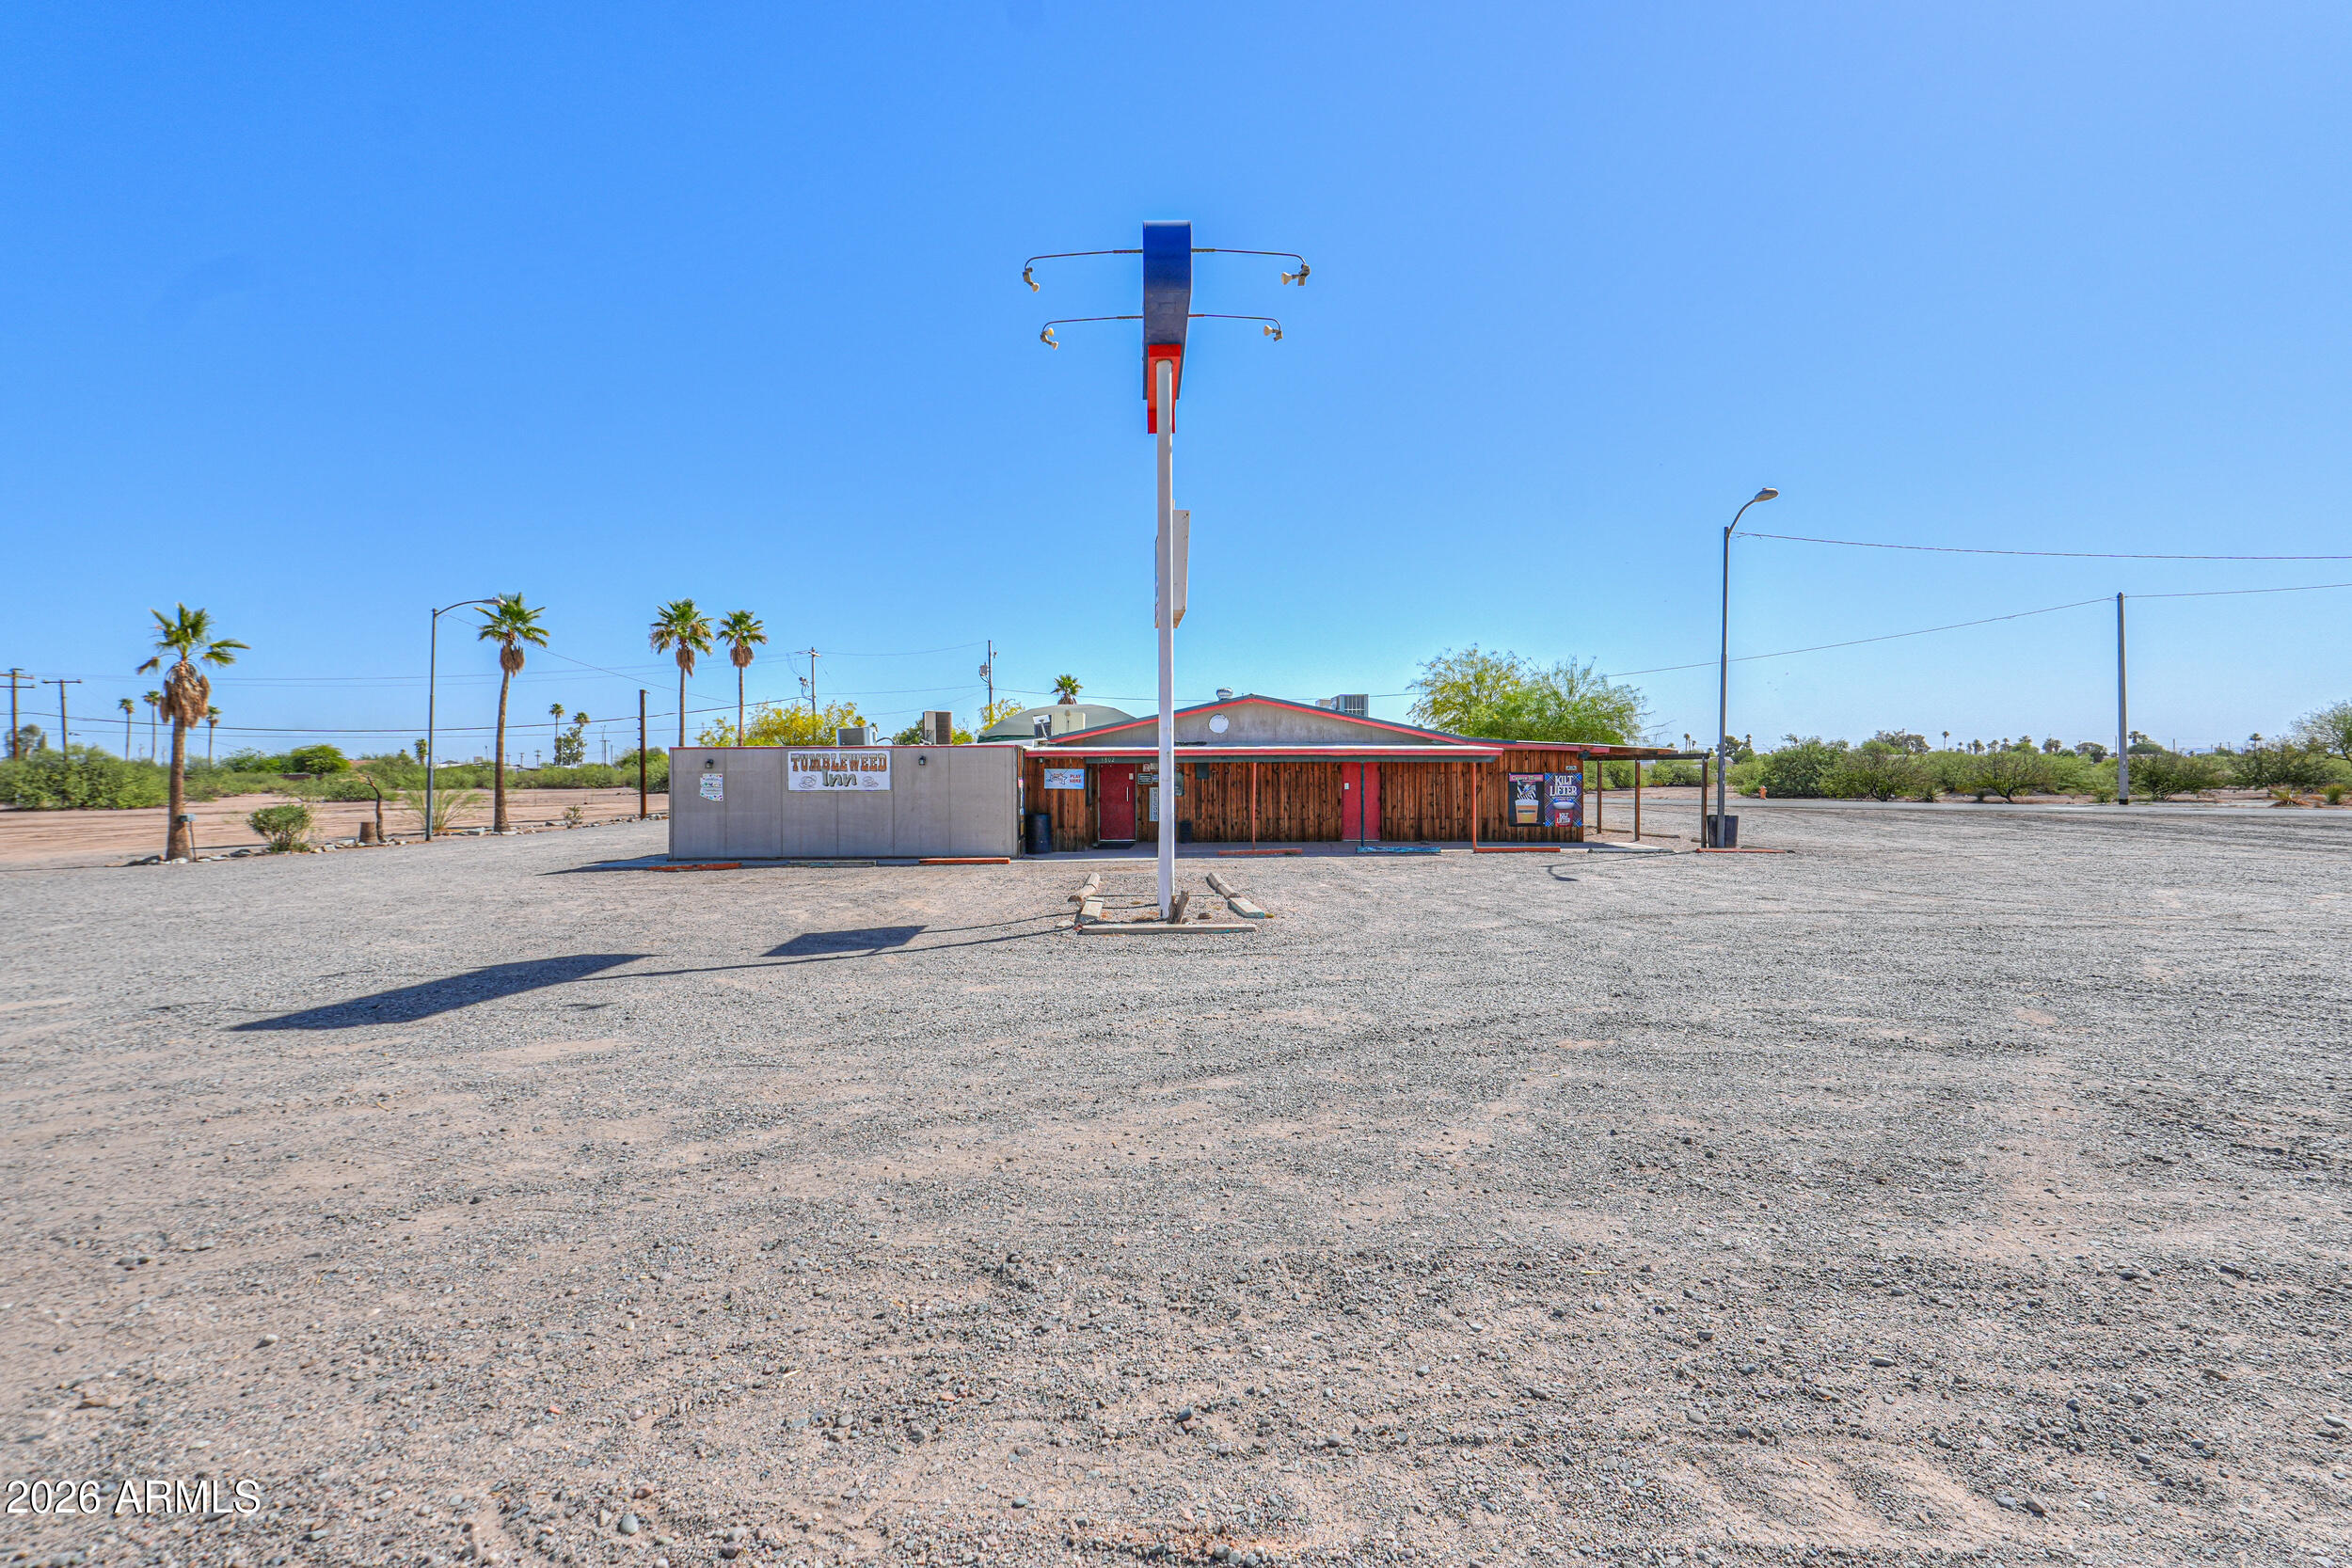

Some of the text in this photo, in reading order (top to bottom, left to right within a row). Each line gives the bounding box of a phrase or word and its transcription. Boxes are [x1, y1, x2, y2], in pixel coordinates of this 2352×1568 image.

[791, 753, 887, 771] TUMBLEWEED
[821, 768, 857, 786] Inn
[1554, 776, 1574, 786] KILT
[1549, 785, 1578, 796] LIFTER
